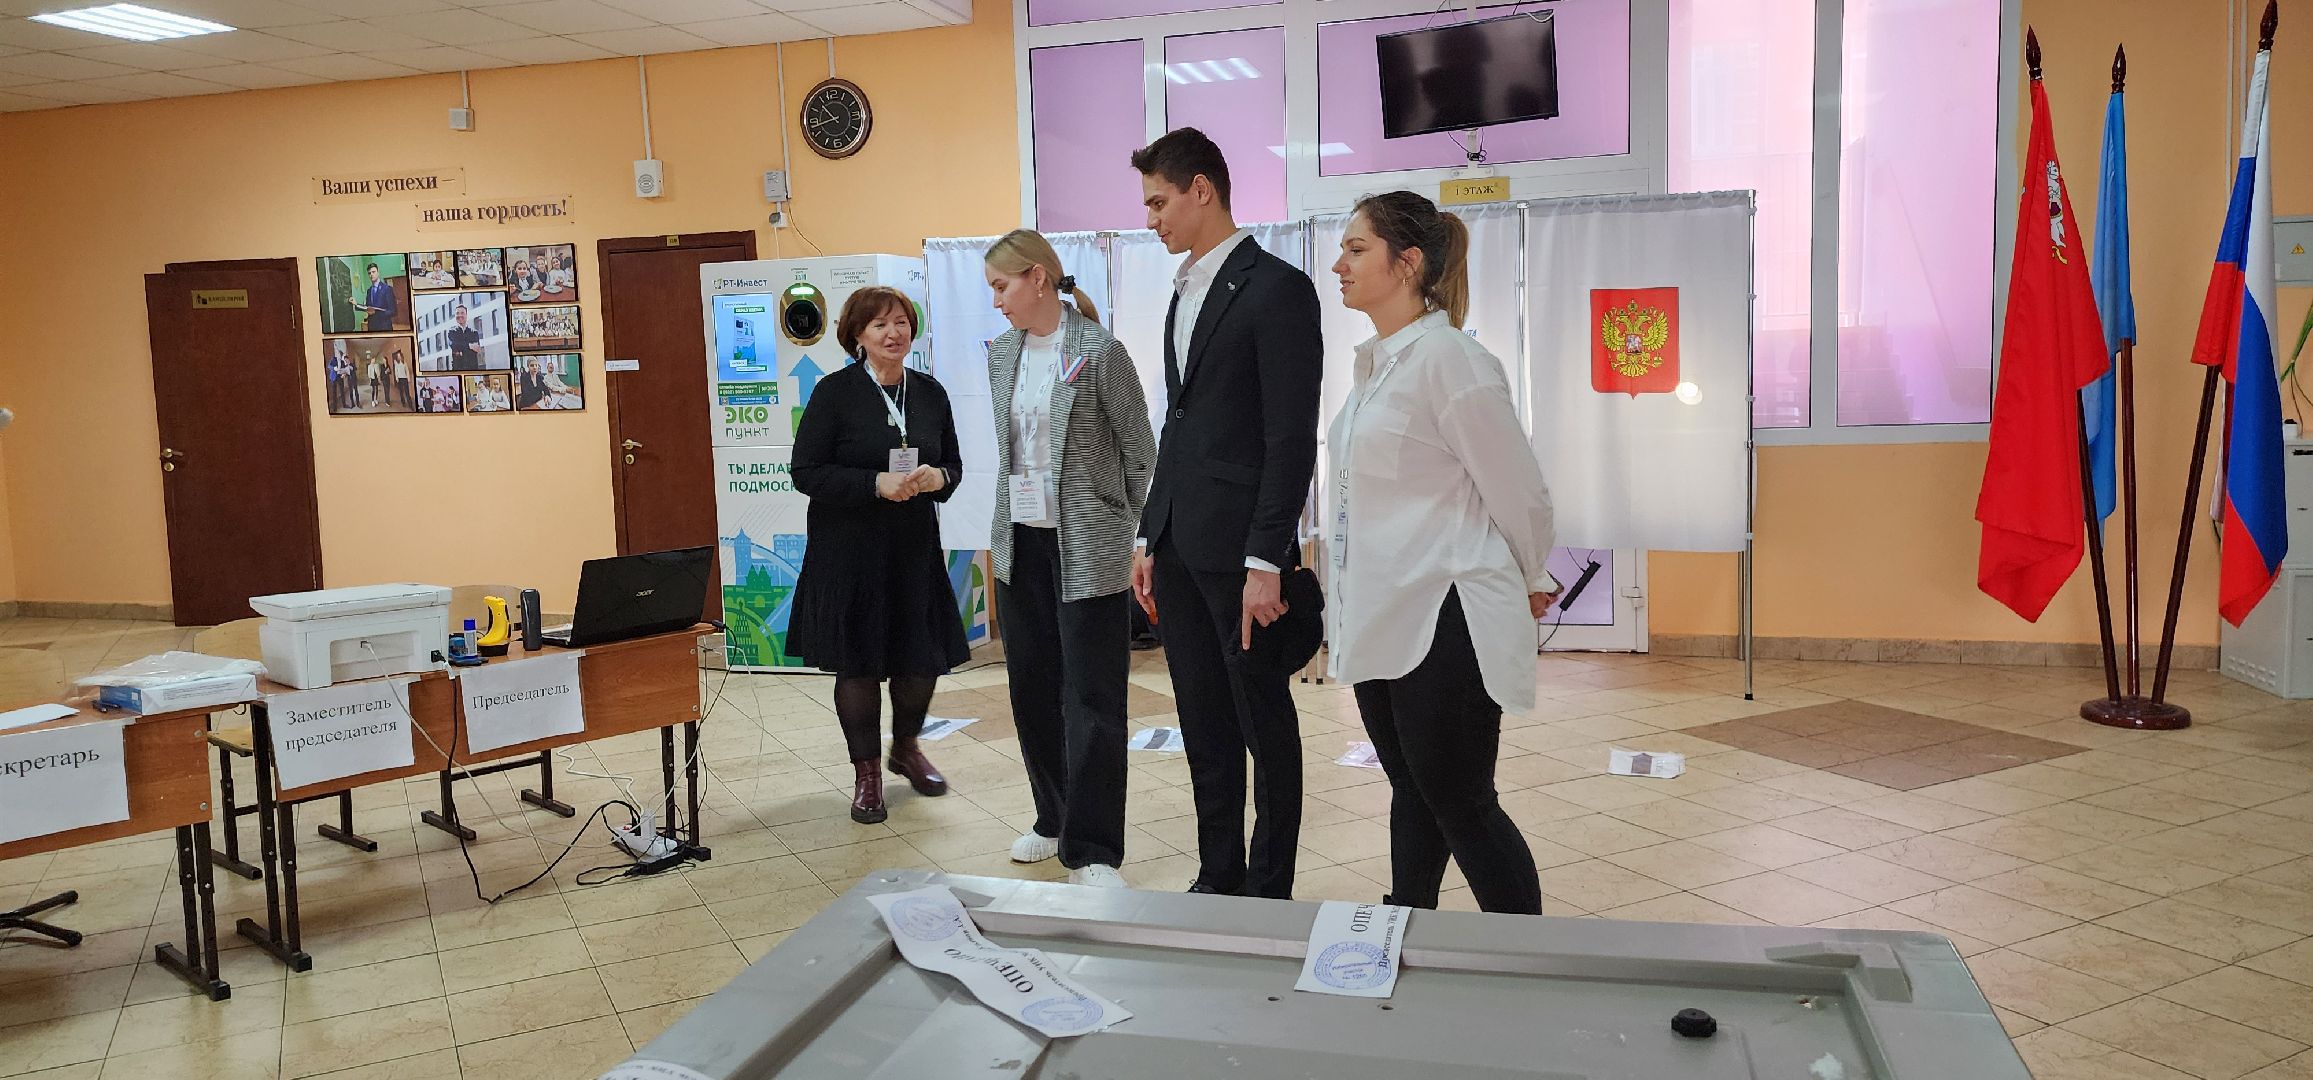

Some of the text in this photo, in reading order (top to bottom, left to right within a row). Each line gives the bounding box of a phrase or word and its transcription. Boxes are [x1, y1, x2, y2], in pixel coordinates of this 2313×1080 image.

[826, 90, 838, 100] 12
[833, 139, 842, 148] 6
[322, 179, 371, 195] Ваши
[375, 176, 438, 197] успехи
[1462, 185, 1494, 195] ЭТАЖ
[423, 199, 567, 224] наша гордость!
[725, 406, 768, 424] ЭКО
[728, 463, 746, 475] ТЫ
[472, 684, 570, 710] Председатель
[286, 699, 392, 725] Заместитель
[286, 721, 397, 752] председателя
[0, 749, 100, 777] кретарь
